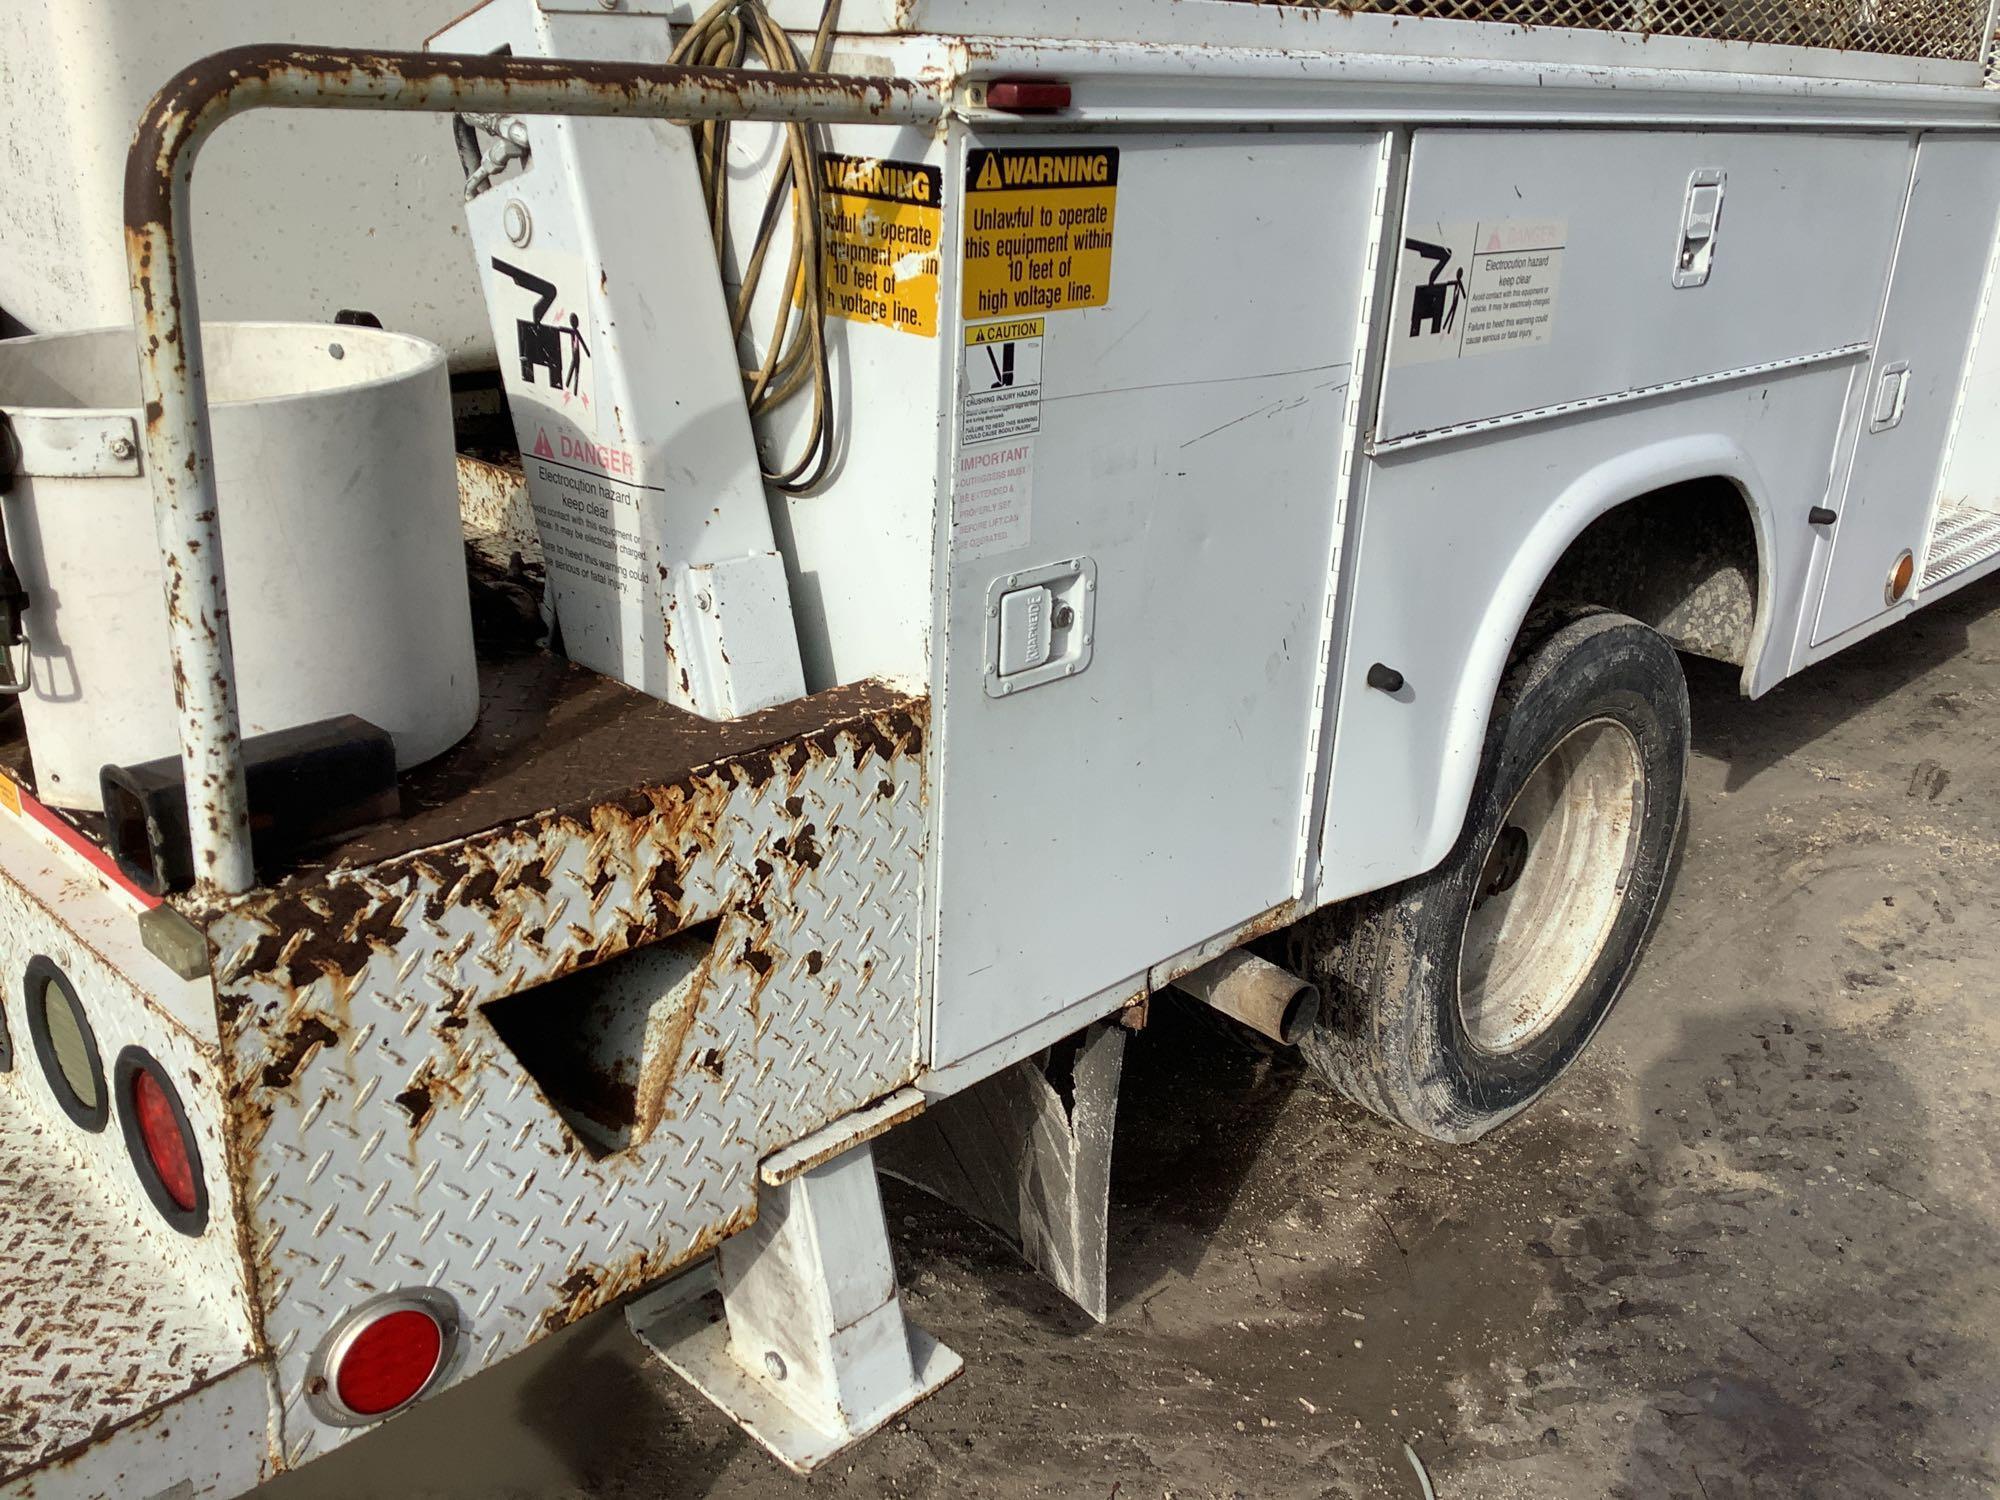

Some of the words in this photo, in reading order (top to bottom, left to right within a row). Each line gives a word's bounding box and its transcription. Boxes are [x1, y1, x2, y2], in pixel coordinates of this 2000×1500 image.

[825, 160, 929, 201] WARNING
[1003, 155, 1108, 184] WARNING
[974, 207, 1034, 230] Unlawful
[1041, 207, 1052, 224] to
[1058, 204, 1107, 230] operate
[881, 222, 931, 246] operate
[965, 237, 989, 258] this
[996, 232, 1068, 260] equipment
[1074, 230, 1112, 250] within
[1008, 261, 1022, 282] 10
[1028, 260, 1053, 279] feet
[1058, 257, 1072, 277] of
[1486, 258, 1526, 271] Electrocution
[1528, 256, 1549, 267] hazard
[833, 263, 847, 284] 10
[854, 270, 881, 291] feet
[884, 275, 896, 294] of
[1499, 276, 1514, 287] keep
[1516, 275, 1532, 285] clear
[840, 293, 886, 321] voltage
[893, 302, 922, 326] line.
[978, 290, 1007, 314] high
[1013, 283, 1061, 308] voltage
[1067, 280, 1095, 301] line.
[1493, 302, 1501, 312] may
[988, 322, 1036, 339] CAUTION
[1468, 321, 1485, 331] Failure
[1486, 321, 1491, 329] to
[1492, 319, 1505, 328] heed
[1506, 318, 1514, 326] this
[1516, 316, 1534, 326] warning
[1535, 314, 1548, 322] could
[1466, 335, 1481, 344] cause
[1482, 333, 1500, 342] serious
[966, 396, 994, 407] CRUSHING
[560, 436, 634, 476] DANGER
[961, 446, 1029, 471] IMPORTANT
[539, 466, 596, 495] Electrocution
[599, 483, 630, 505] hazard
[562, 494, 585, 512] keep
[587, 502, 608, 519] clear
[548, 508, 570, 521] contact
[572, 515, 584, 526] with
[586, 518, 597, 530] this
[599, 524, 632, 542] equipment
[561, 526, 574, 538] may
[575, 530, 583, 539] be
[585, 533, 617, 553] electrically
[620, 544, 647, 560] charged.
[556, 560, 580, 575] serious
[582, 569, 590, 578] or
[591, 571, 606, 584] fatal
[557, 545, 564, 554] to
[565, 548, 583, 561] heed
[584, 553, 598, 567] this
[599, 560, 627, 579] warning
[629, 570, 648, 584] could
